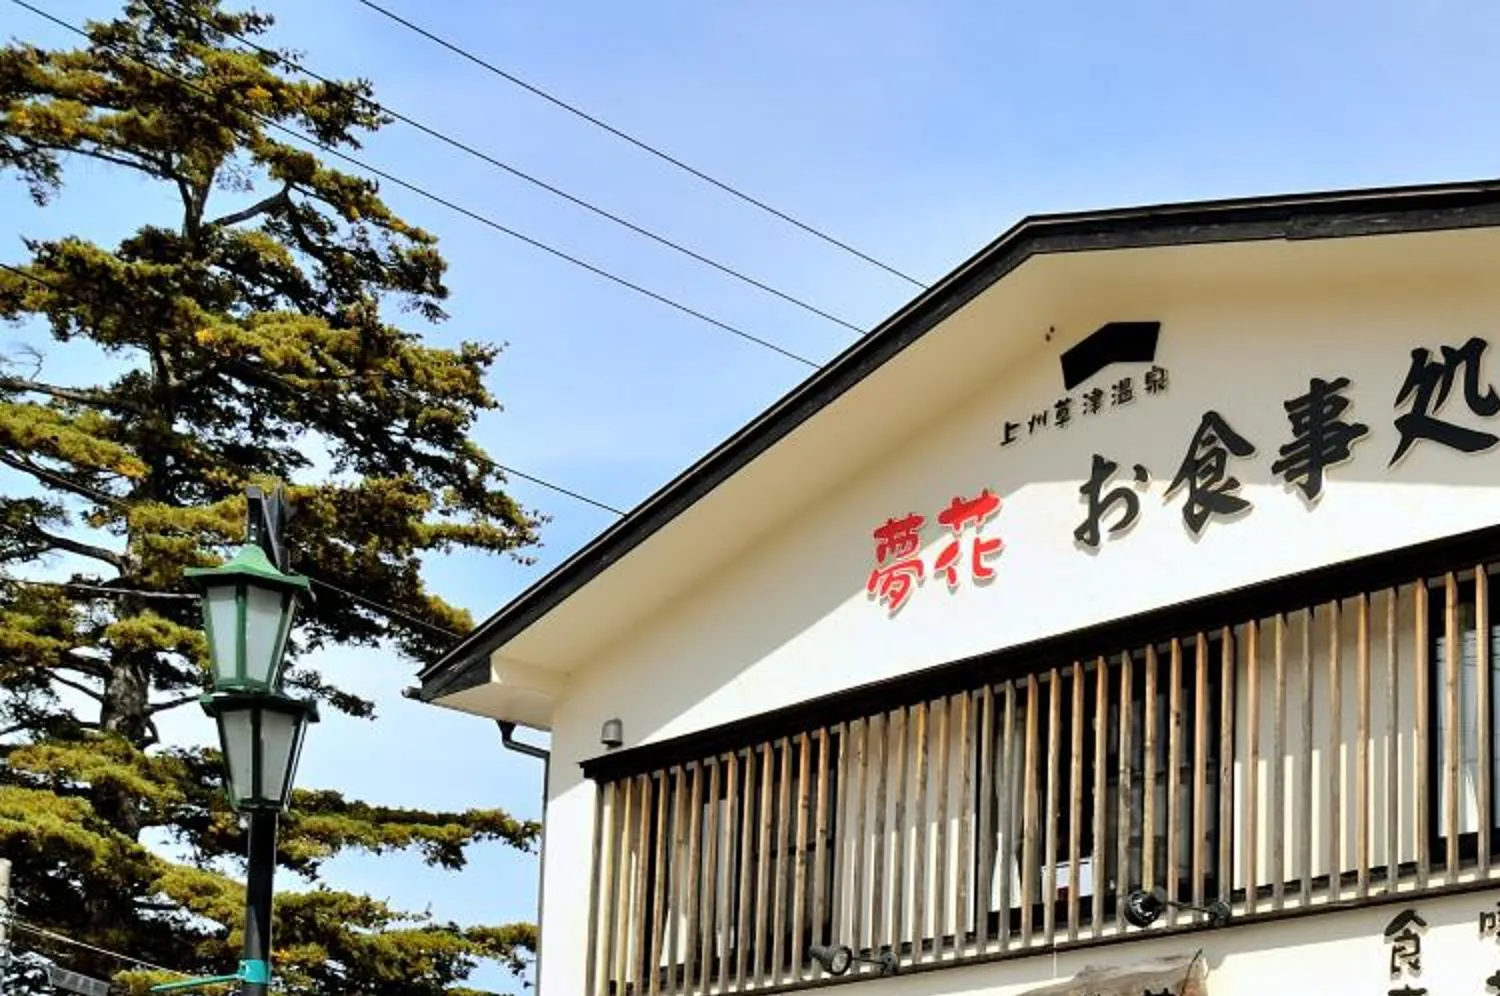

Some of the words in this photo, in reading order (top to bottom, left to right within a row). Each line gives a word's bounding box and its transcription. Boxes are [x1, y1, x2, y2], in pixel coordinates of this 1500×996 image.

[1000, 366, 1169, 446] 上州草津温泉
[866, 489, 1004, 615] 夢花
